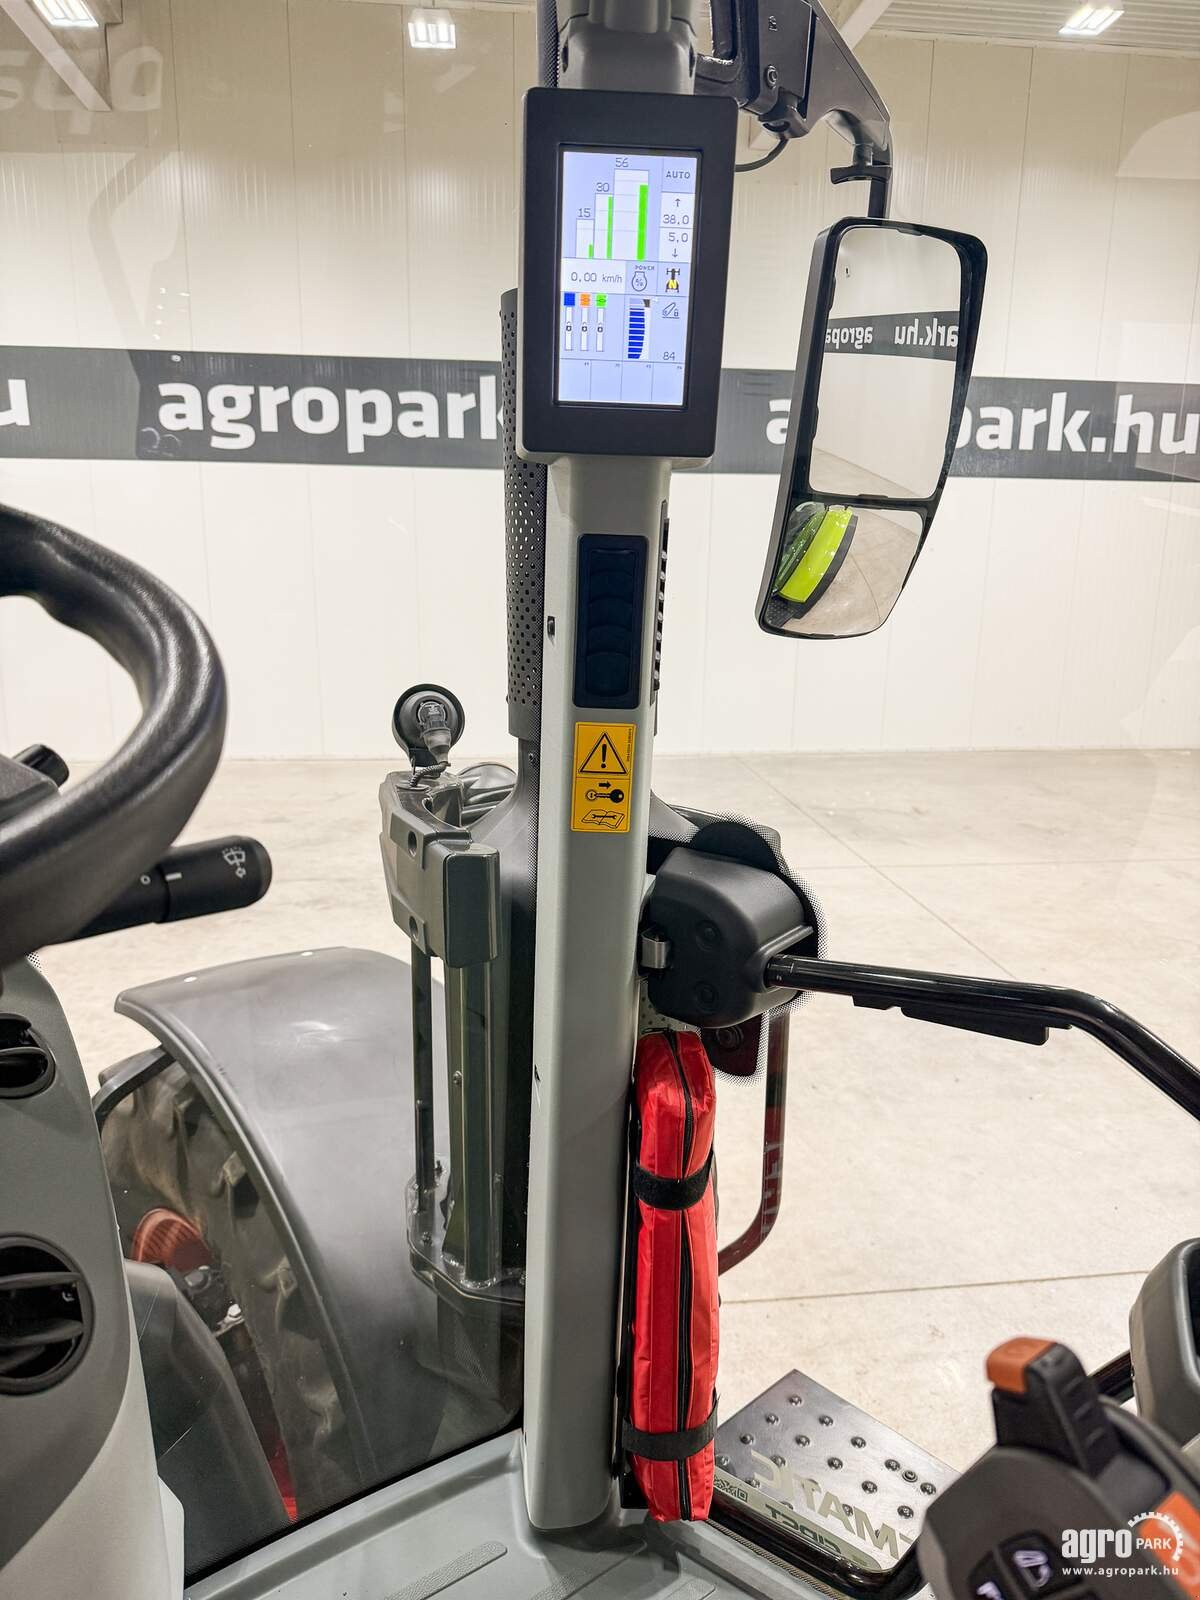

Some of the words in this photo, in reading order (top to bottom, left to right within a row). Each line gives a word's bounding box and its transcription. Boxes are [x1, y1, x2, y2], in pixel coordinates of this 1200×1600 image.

[615, 157, 629, 168] 56
[665, 170, 691, 180] AUTO
[596, 182, 610, 193] 30
[578, 207, 591, 218] 15
[662, 214, 690, 225] 38.0
[668, 232, 689, 243] 5.0
[570, 271, 598, 283] 0.00
[601, 273, 623, 284] km/h
[662, 351, 676, 361] 84
